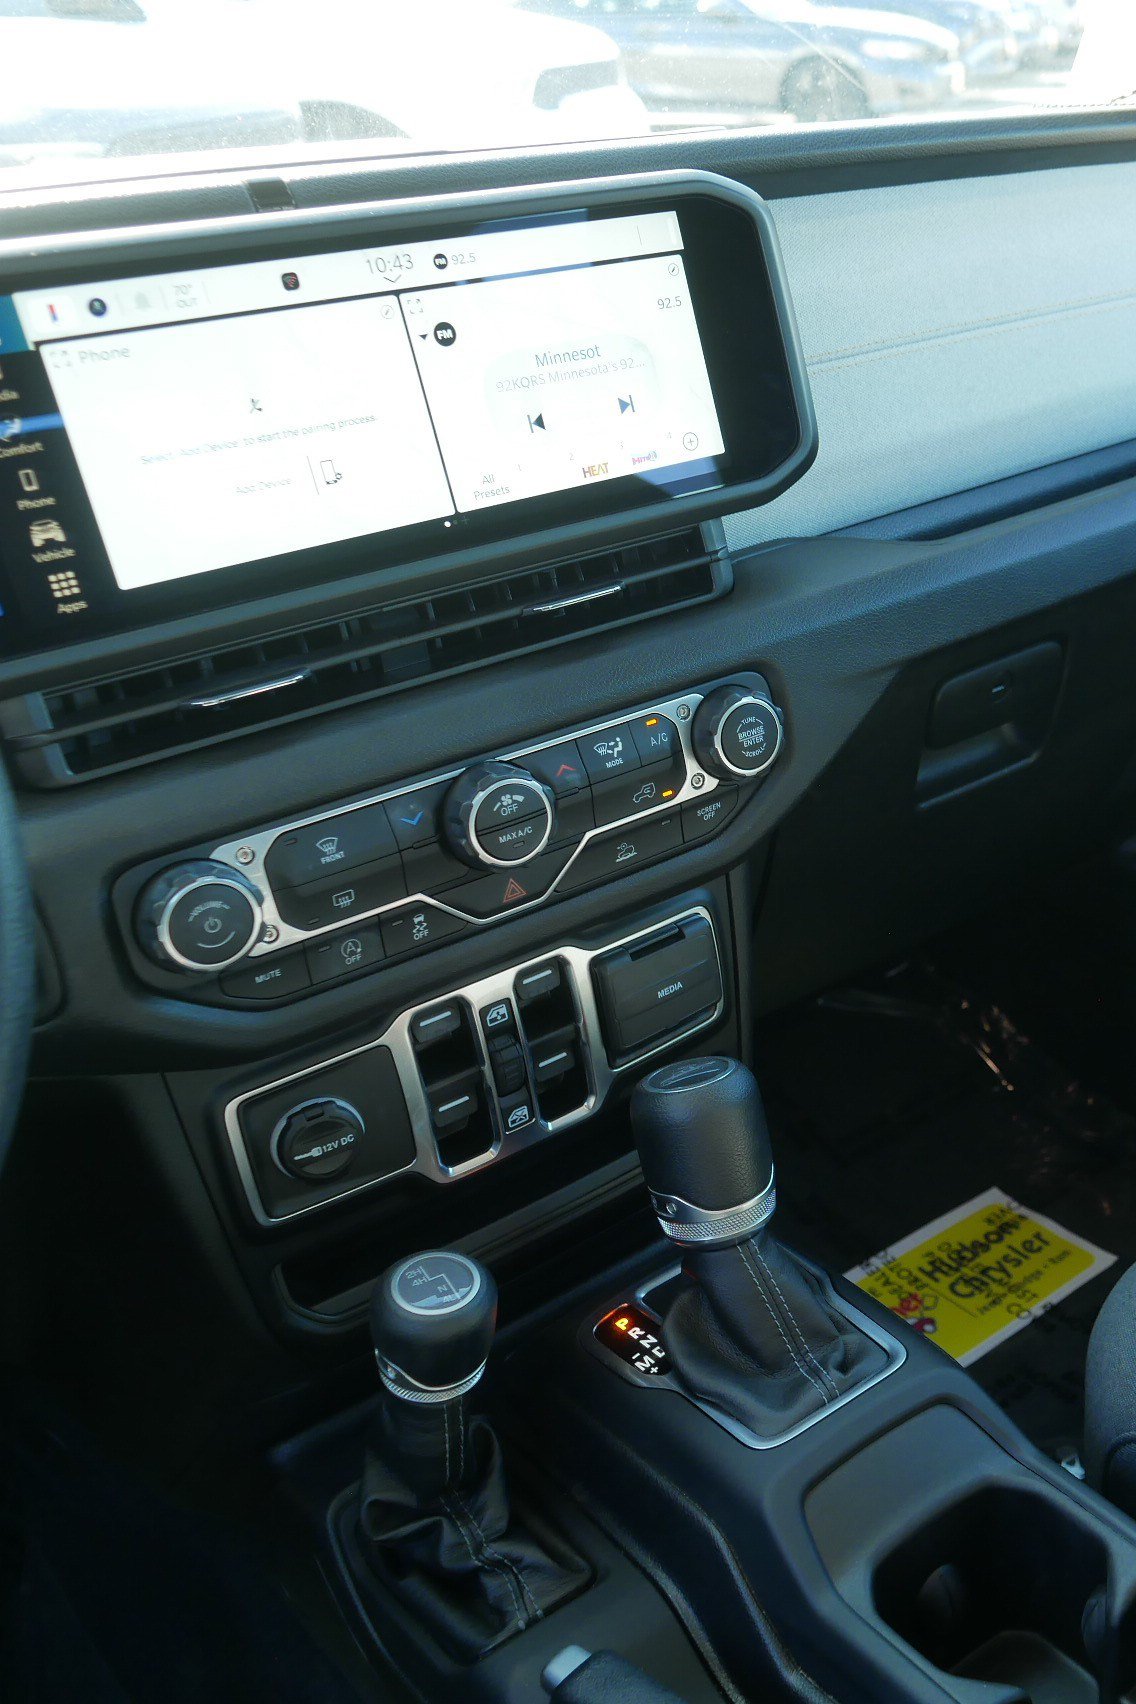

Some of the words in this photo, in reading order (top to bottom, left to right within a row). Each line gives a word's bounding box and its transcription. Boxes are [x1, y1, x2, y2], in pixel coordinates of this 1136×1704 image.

[366, 253, 414, 275] 10:43
[451, 252, 476, 265] 92.5
[657, 296, 682, 310] 92.5
[436, 329, 454, 342] FM
[79, 346, 130, 364] Phone
[535, 345, 601, 367] Minnesot
[496, 374, 546, 392] 92KQRS
[548, 362, 618, 383] Minnesota's
[257, 432, 281, 443] start
[283, 428, 299, 439] the
[302, 421, 336, 435] pairing
[582, 462, 609, 479] HEAT
[482, 474, 496, 485] All
[474, 486, 511, 501] Presets
[650, 732, 668, 747] A/C
[738, 726, 764, 740] BROWSE
[743, 735, 764, 748] ENTER
[605, 758, 624, 769] MODE
[500, 803, 519, 816] OFF
[697, 802, 721, 817] SCREEN
[703, 811, 716, 821] OFF
[499, 832, 517, 844] MAX
[518, 826, 533, 838] A/C
[413, 929, 429, 941] OFF
[345, 954, 362, 965] OFF
[254, 968, 282, 984] MUTE
[657, 981, 683, 999] MEDIA
[323, 1141, 339, 1153] 12V
[340, 1134, 355, 1146] DC
[950, 1231, 1050, 1298] Chrysler
[406, 1268, 423, 1280] 2H
[437, 1284, 448, 1293] N
[615, 1318, 629, 1331] P
[627, 1327, 645, 1340] R
